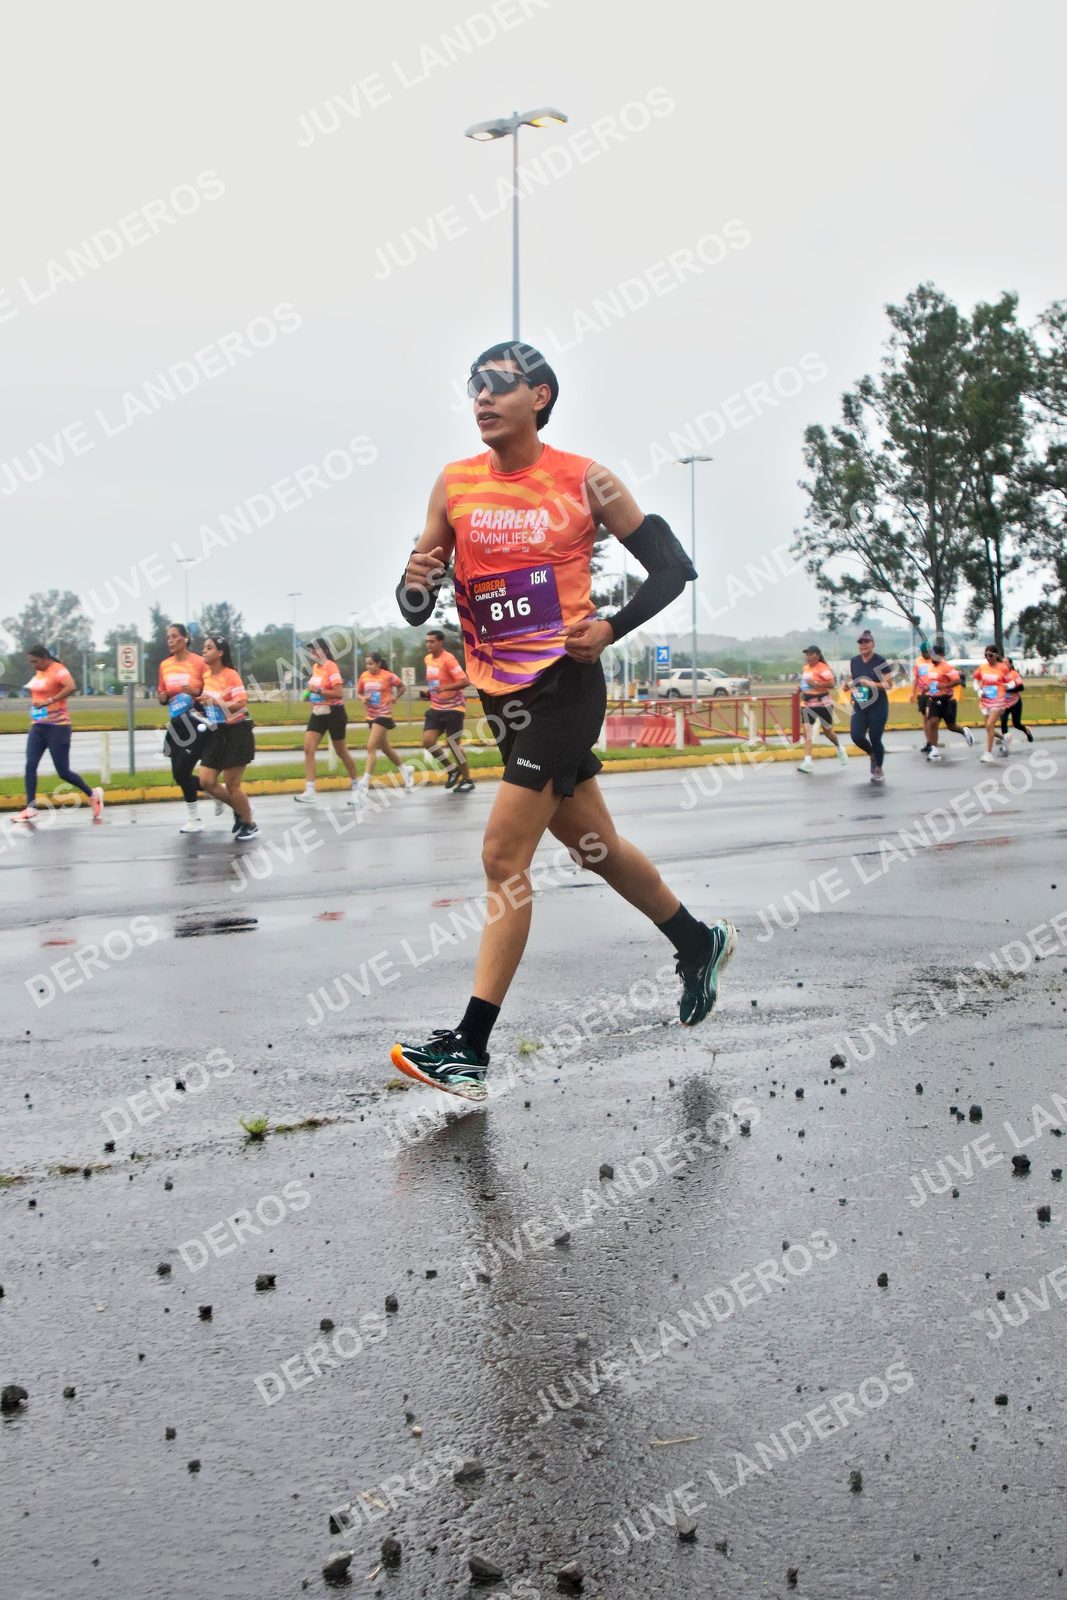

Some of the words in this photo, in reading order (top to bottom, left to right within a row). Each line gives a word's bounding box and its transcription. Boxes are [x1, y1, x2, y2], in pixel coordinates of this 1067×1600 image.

[470, 507, 549, 530] CARRERA
[469, 530, 528, 545] OMNILIFE
[529, 570, 548, 585] 15K
[473, 578, 506, 594] CARRERA
[475, 591, 499, 602] OMNILIFE
[490, 596, 531, 621] 816
[516, 757, 541, 771] Wilson
